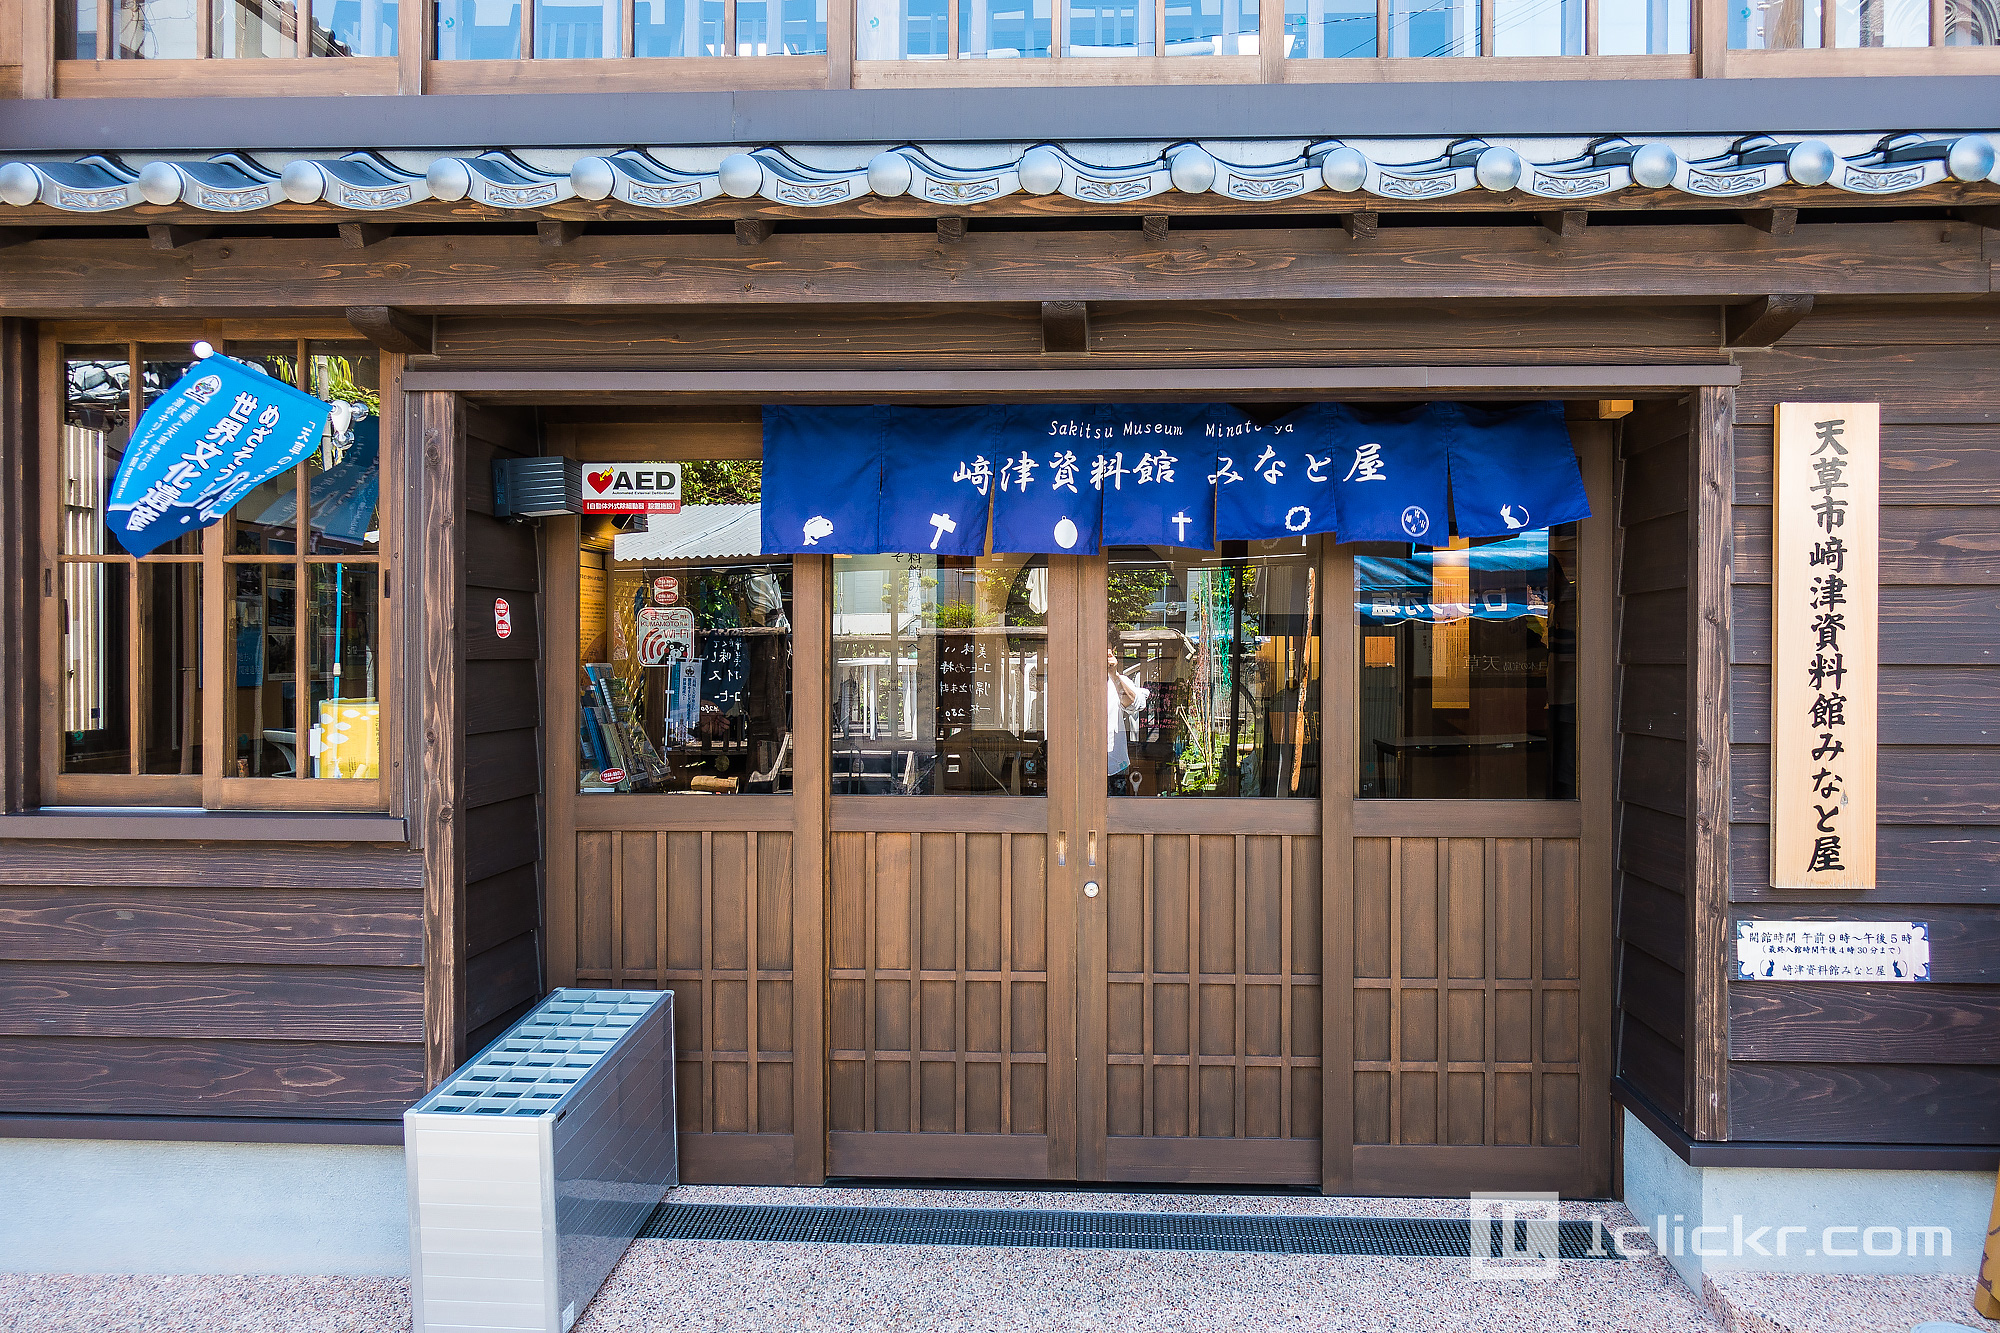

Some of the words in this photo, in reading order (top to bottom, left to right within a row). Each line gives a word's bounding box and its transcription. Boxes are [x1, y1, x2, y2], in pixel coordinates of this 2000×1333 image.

[1048, 420, 1114, 440] Sakitsu
[1123, 421, 1184, 437] Museum
[126, 391, 258, 531] 世界文化遺産
[1208, 443, 1388, 486] みなと屋
[612, 471, 676, 490] AED
[641, 611, 680, 620] くまもと
[662, 629, 689, 639] Wi-Fi
[1749, 932, 1796, 944] 開館時間
